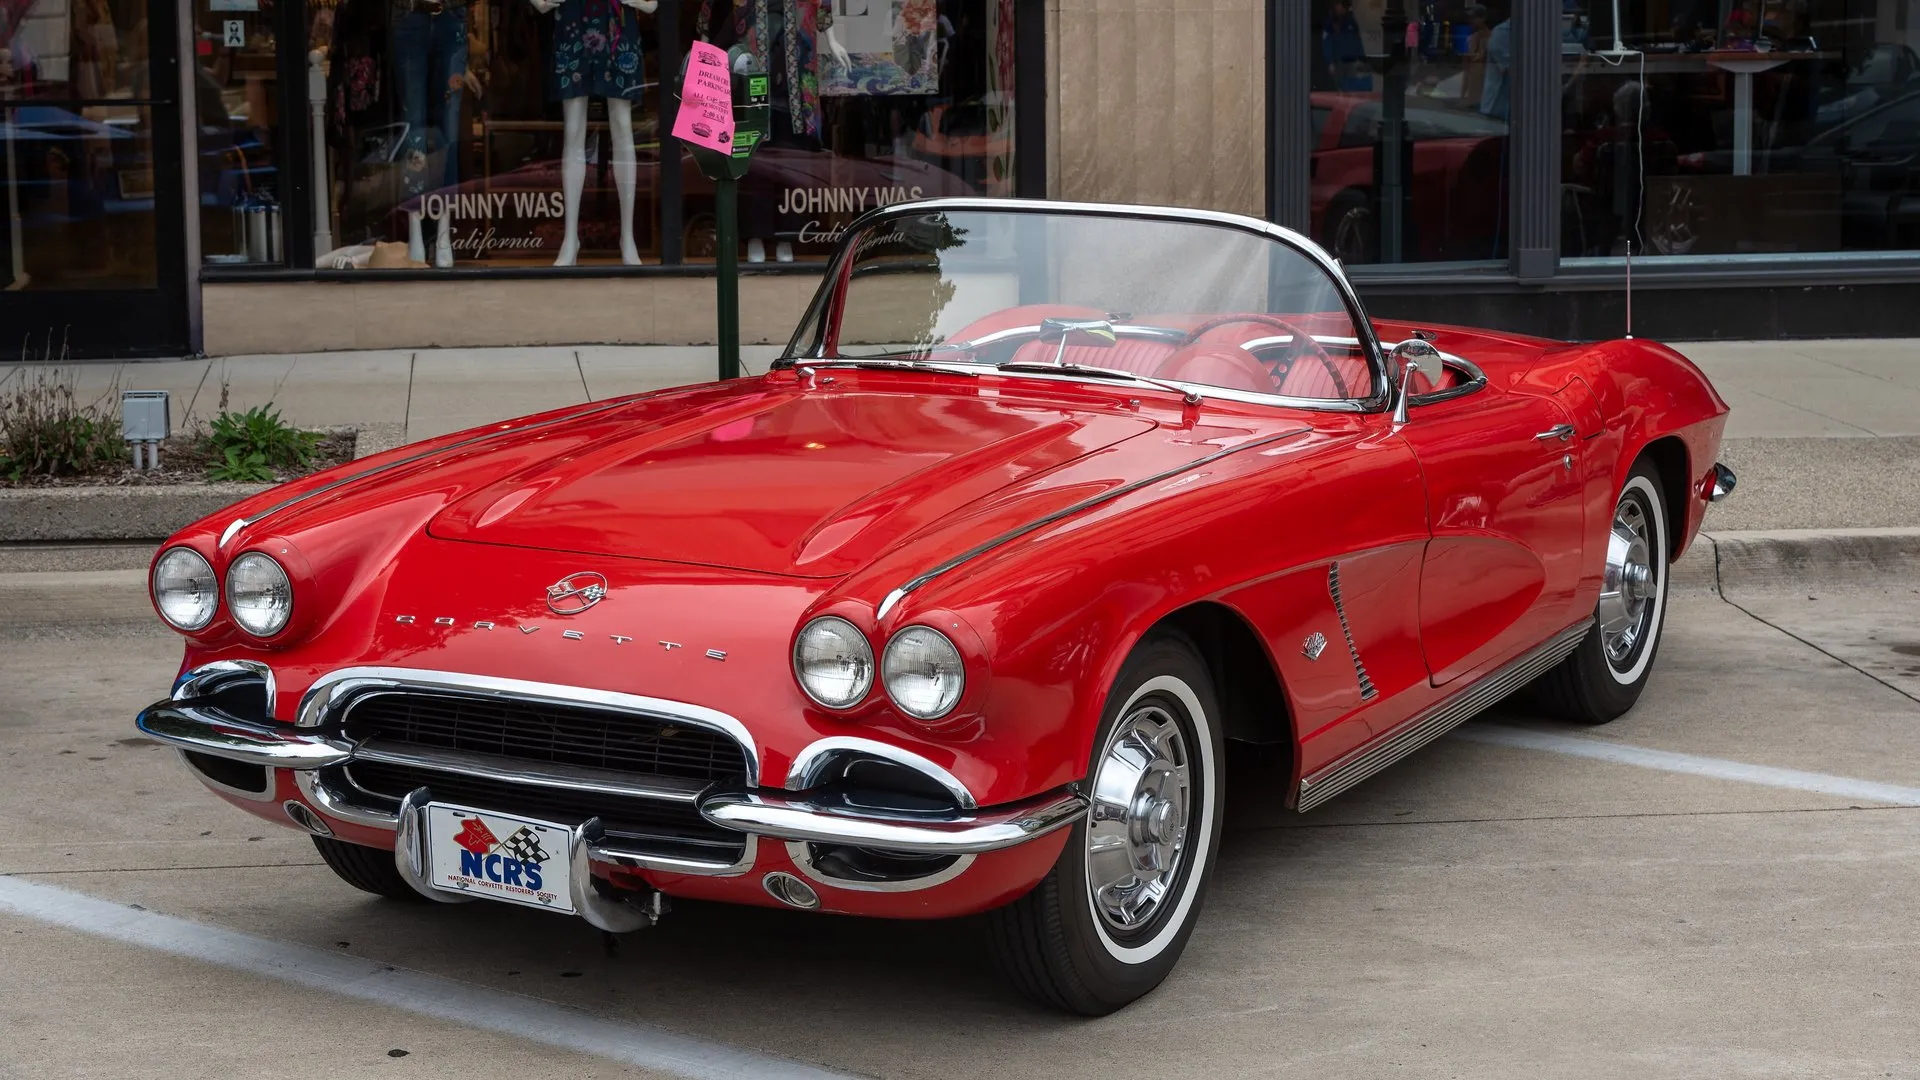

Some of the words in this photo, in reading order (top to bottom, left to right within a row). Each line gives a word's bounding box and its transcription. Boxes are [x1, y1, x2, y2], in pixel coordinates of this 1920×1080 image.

[697, 79, 723, 92] PARKING
[418, 193, 508, 221] JOHNNY
[513, 191, 565, 219] WAS
[778, 187, 869, 214] JOHNNY
[437, 226, 545, 259] California
[396, 615, 728, 662] CORVETTE
[460, 848, 543, 891] NCRS
[447, 874, 476, 885] NATIONAL
[477, 880, 503, 890] CORVETTE
[505, 885, 535, 896] RESTORERS
[536, 891, 558, 901] SOCIETY
